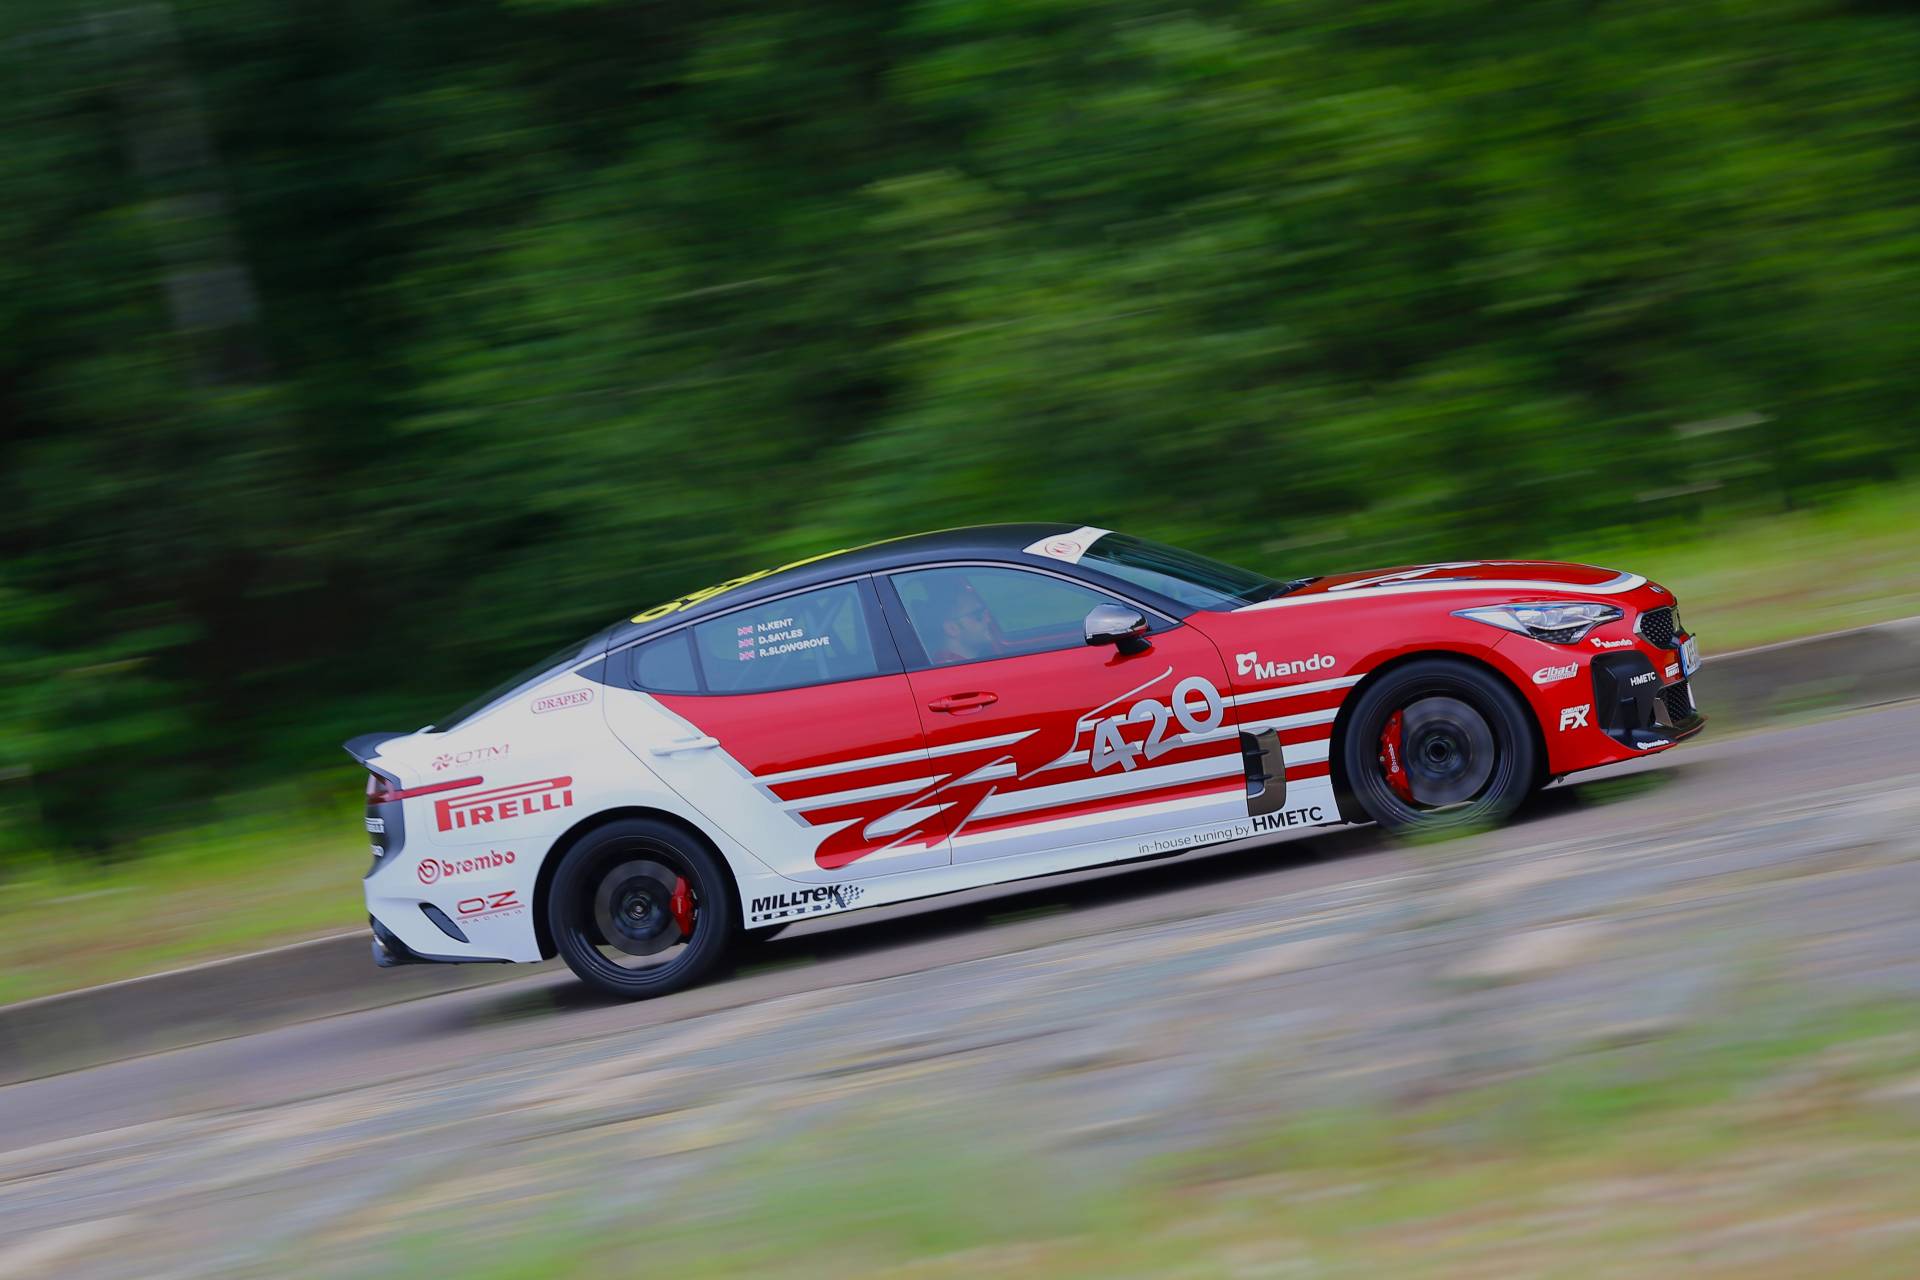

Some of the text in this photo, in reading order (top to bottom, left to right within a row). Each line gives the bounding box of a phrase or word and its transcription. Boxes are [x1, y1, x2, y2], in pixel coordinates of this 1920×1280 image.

[757, 618, 793, 633] N.KENT
[758, 629, 804, 645] D.SAYLES
[759, 636, 830, 658] R.SLOWGROVE
[1254, 653, 1336, 680] Mando
[1630, 671, 1656, 687] HMETC
[1091, 676, 1224, 773] 420
[1559, 705, 1590, 732] FX
[434, 775, 573, 833] PIRELLI
[1138, 806, 1324, 854] in-house tuning by HMETC
[442, 850, 516, 877] brembo
